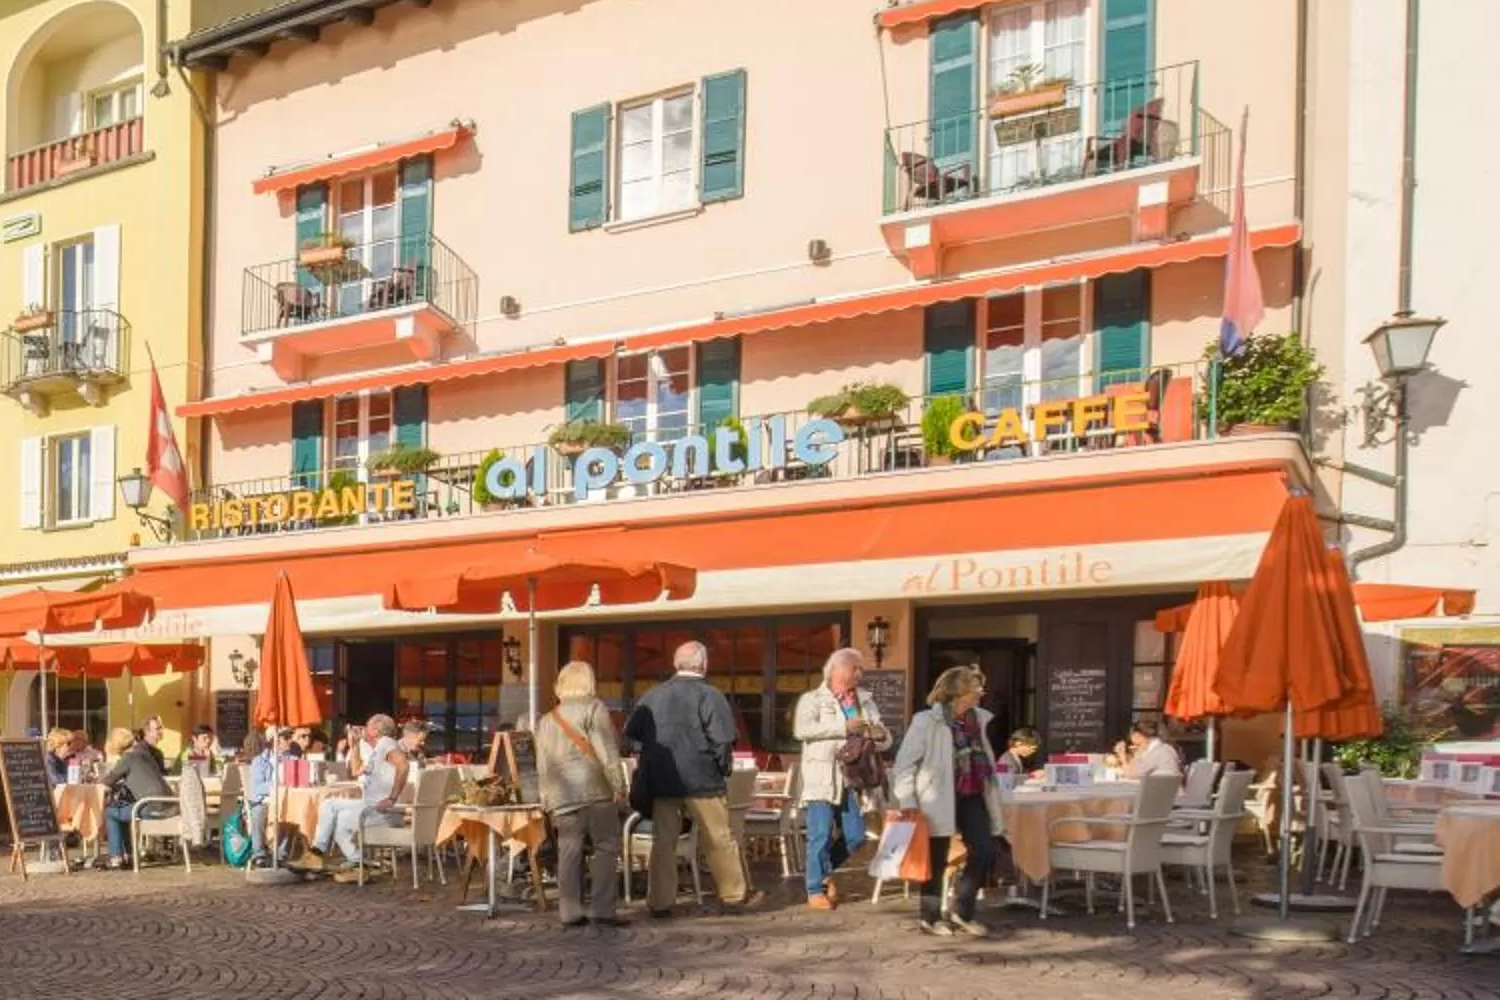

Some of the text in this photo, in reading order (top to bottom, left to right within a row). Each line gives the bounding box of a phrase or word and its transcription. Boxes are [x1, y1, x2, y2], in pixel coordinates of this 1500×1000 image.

[190, 414, 844, 530] RISTORANTE al pontile
[902, 551, 1113, 593] al Pontile
